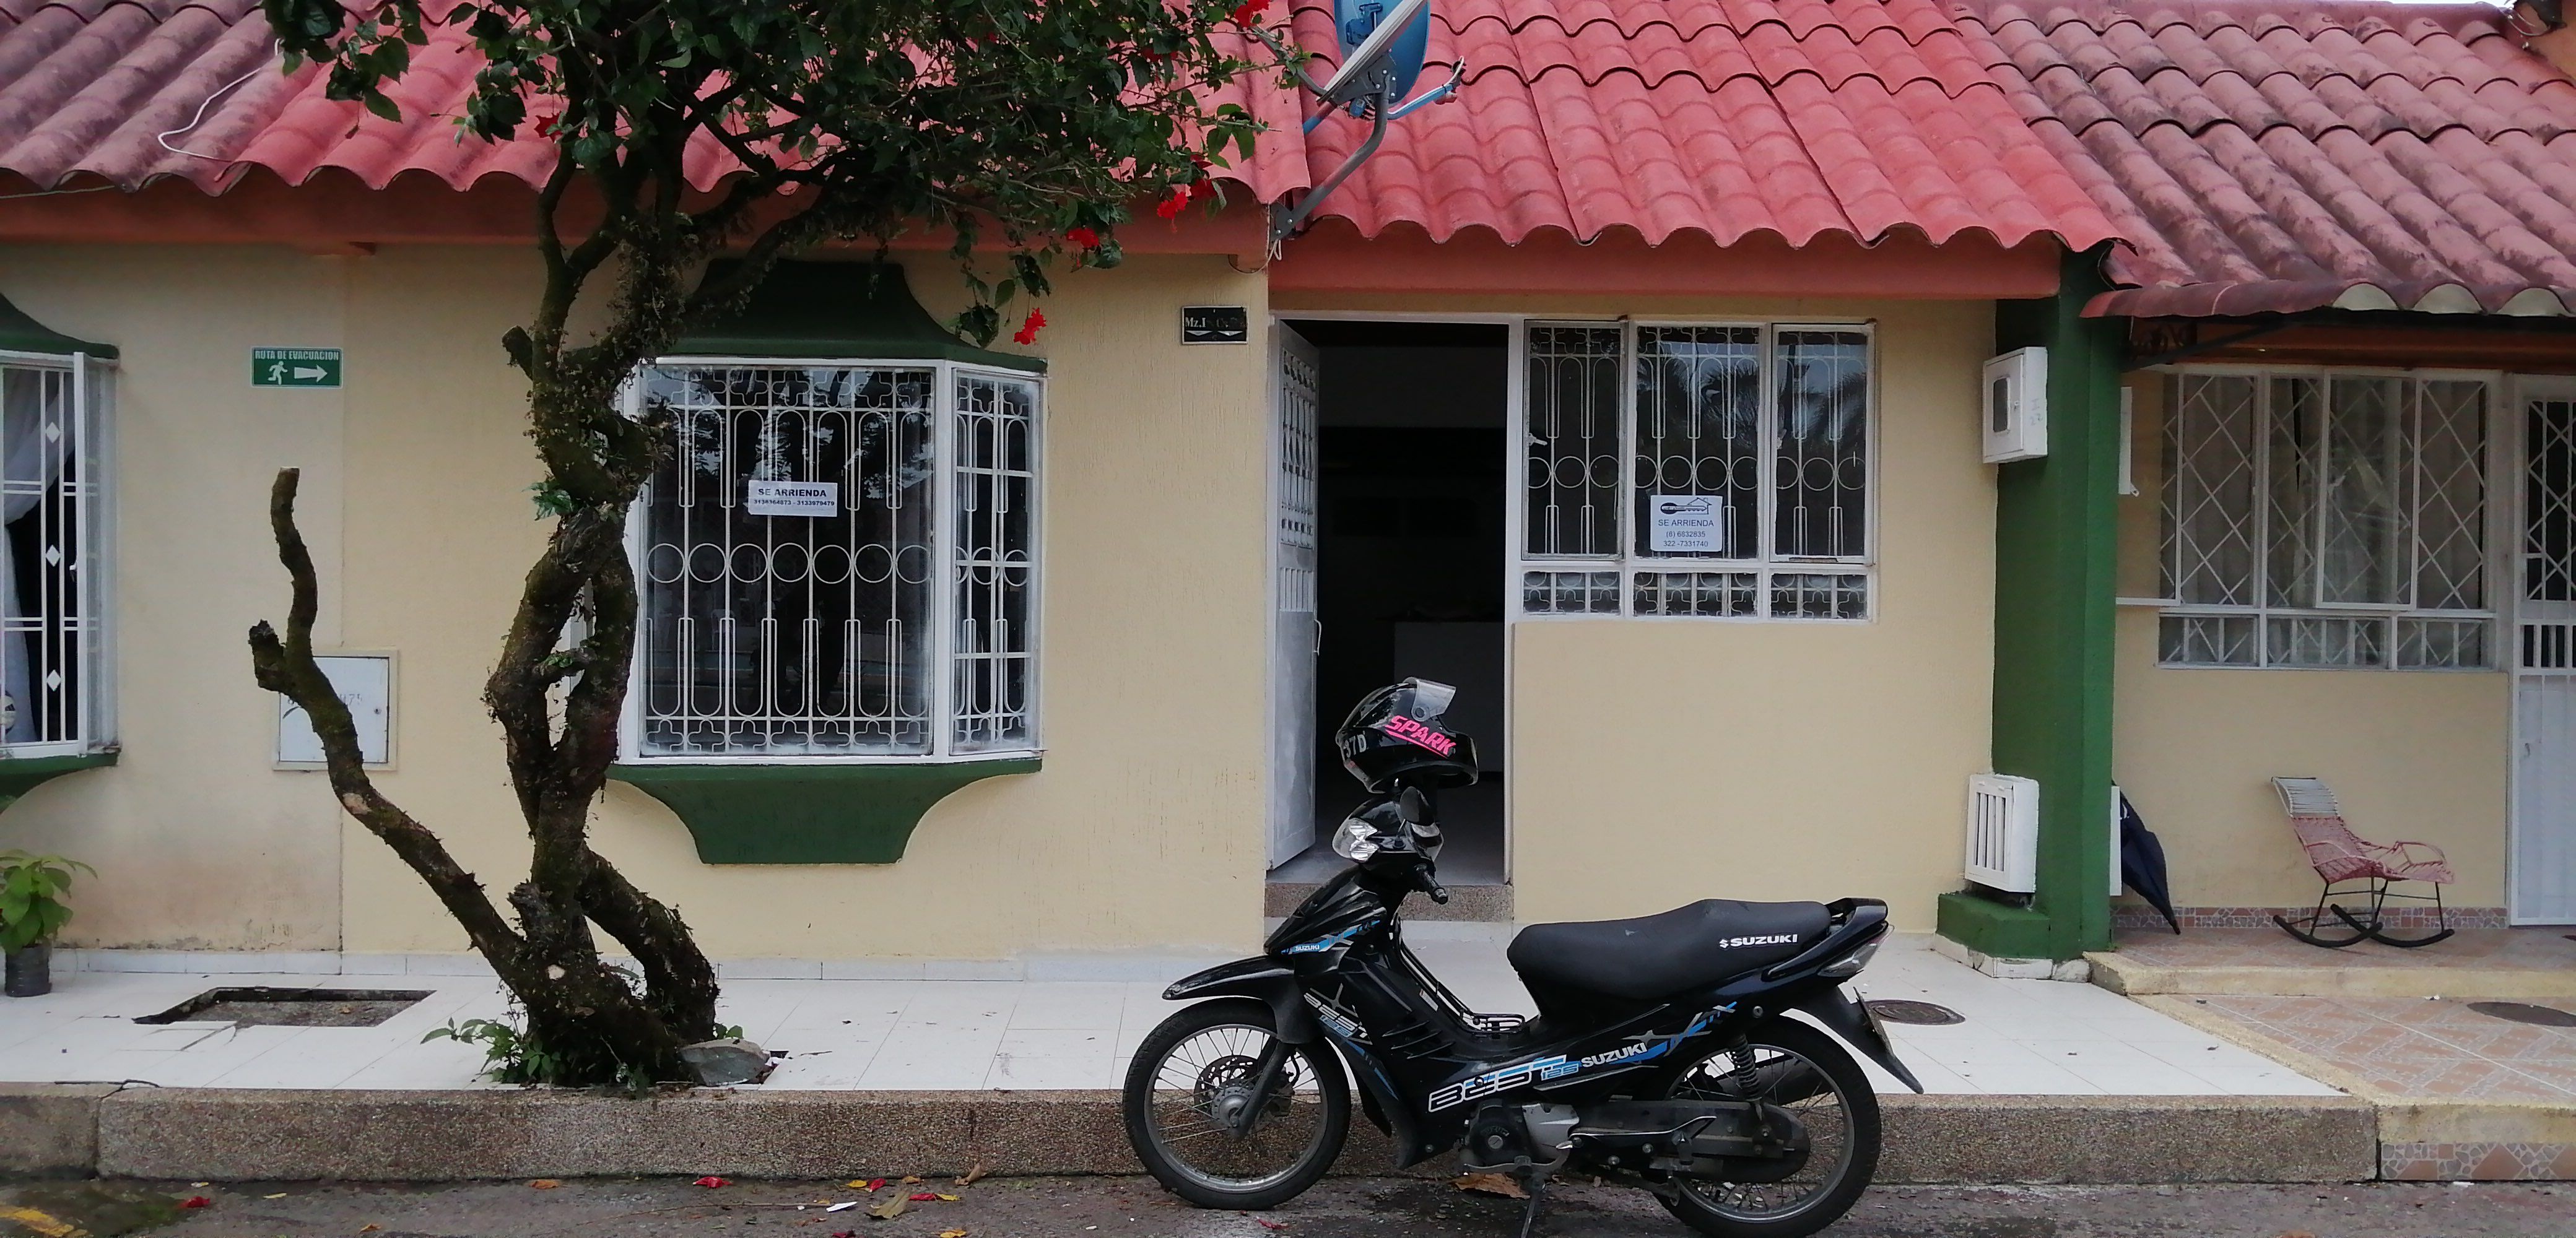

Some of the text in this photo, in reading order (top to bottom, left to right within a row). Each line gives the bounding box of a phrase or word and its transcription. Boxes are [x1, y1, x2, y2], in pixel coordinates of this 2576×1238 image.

[255, 350, 339, 361] RUTA DE EVACUACION
[774, 488, 827, 497] ARRIENDA
[1384, 715, 1456, 755] SPARK
[1730, 934, 1798, 948] SUZUKI
[1541, 1060, 1579, 1081] 125
[1581, 1042, 1648, 1068] SUZUKI
